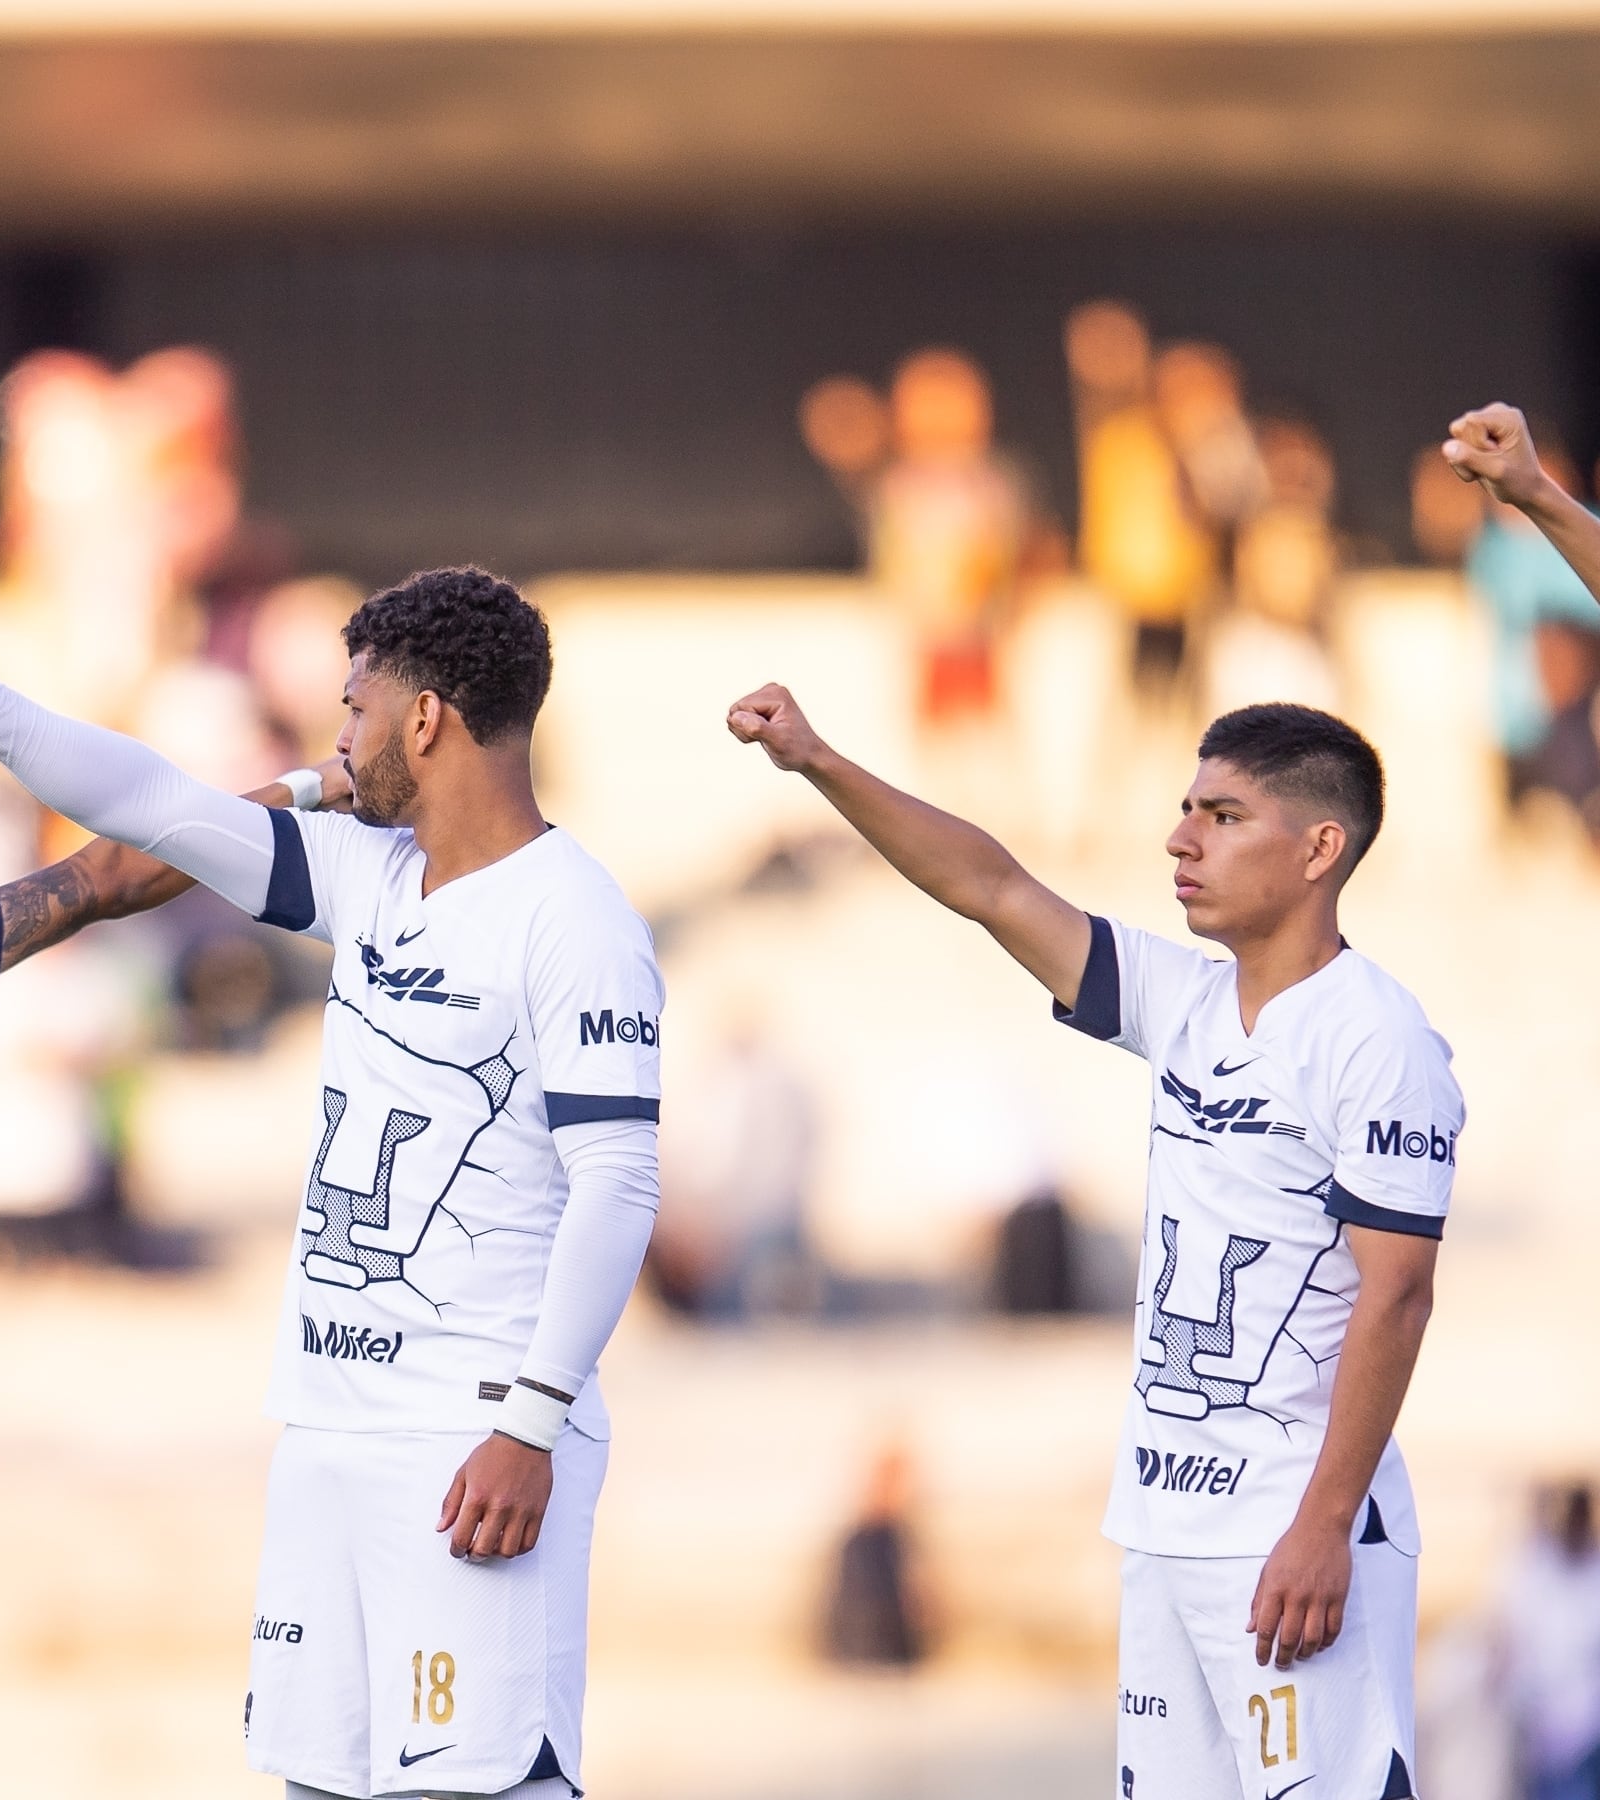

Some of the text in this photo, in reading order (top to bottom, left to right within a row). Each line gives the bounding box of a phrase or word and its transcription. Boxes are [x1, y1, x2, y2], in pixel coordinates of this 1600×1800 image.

[324, 1321, 403, 1363] Mifel
[1161, 1453, 1248, 1496] Mifel
[411, 1650, 456, 1725] 18
[1121, 1688, 1167, 1718] tura
[1248, 1684, 1298, 1769] 27
